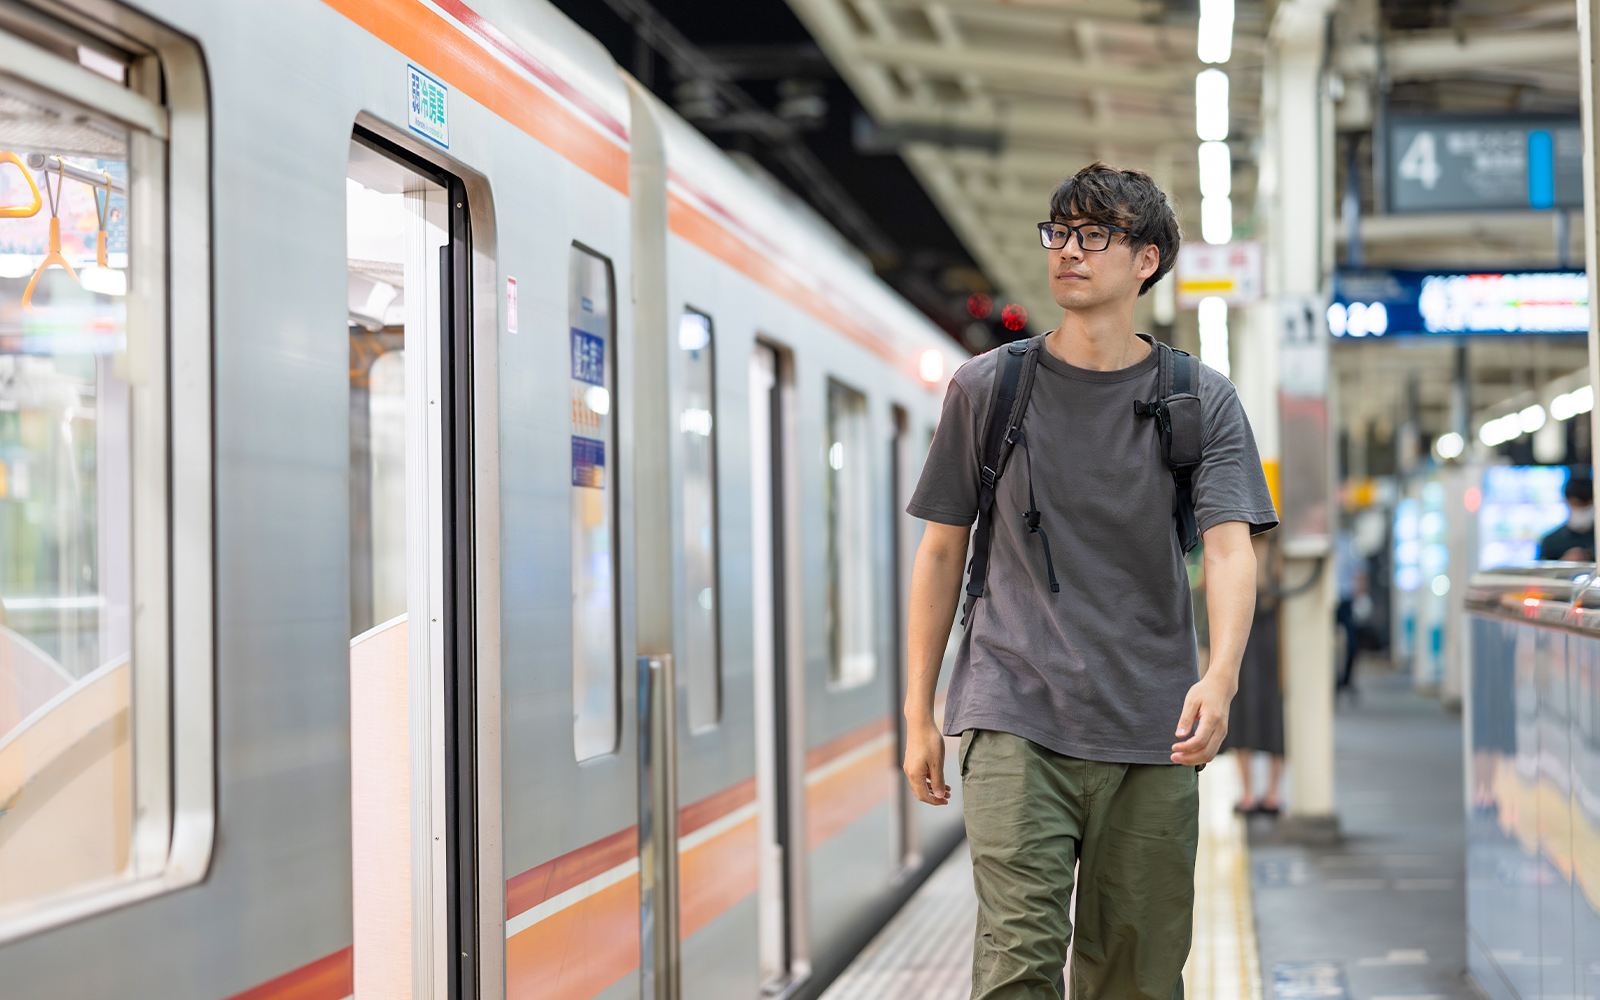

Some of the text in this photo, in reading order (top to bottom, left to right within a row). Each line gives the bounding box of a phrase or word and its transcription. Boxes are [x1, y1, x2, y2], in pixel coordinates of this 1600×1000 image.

[412, 73, 445, 128] 弱冷房車
[1399, 131, 1441, 190] 4
